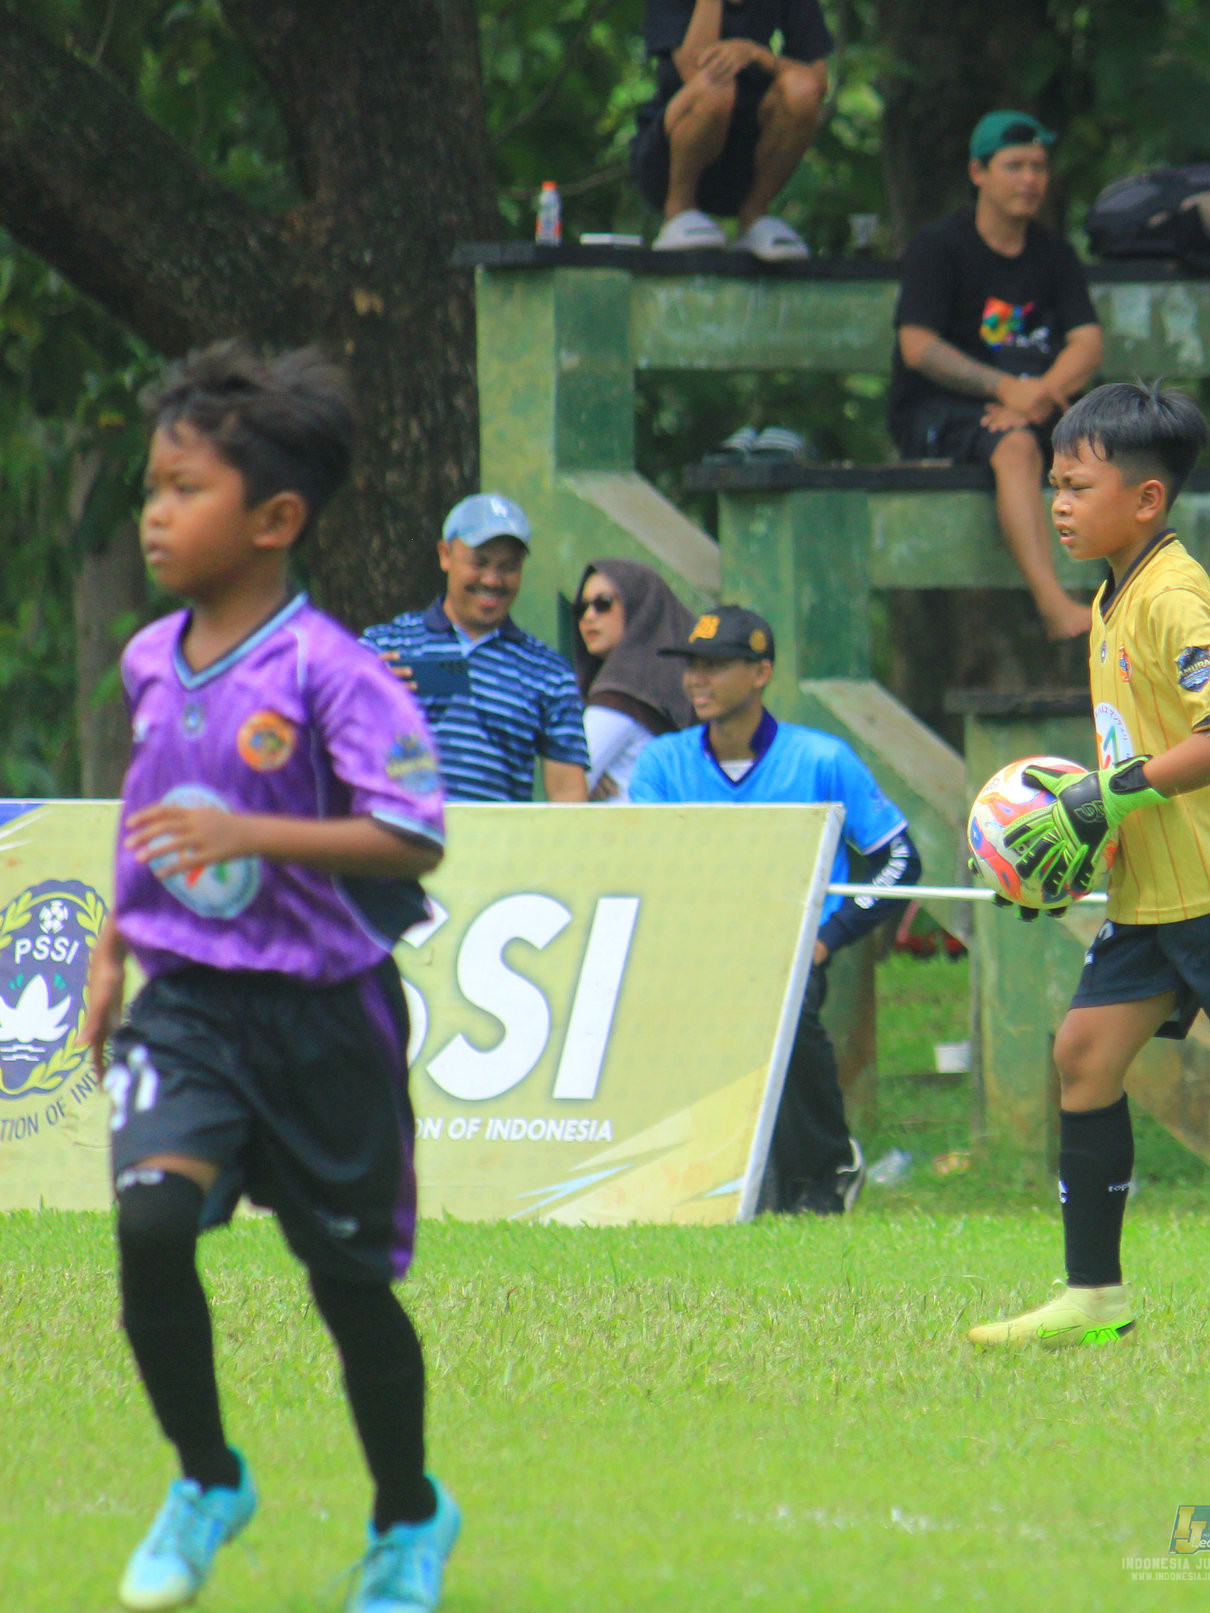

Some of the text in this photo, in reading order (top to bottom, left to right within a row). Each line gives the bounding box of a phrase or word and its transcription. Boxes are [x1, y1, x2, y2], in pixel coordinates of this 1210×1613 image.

[14, 935, 80, 965] PSSI
[45, 1096, 67, 1127] OF
[447, 1117, 482, 1141] OF
[485, 1118, 613, 1142] INDONESIA
